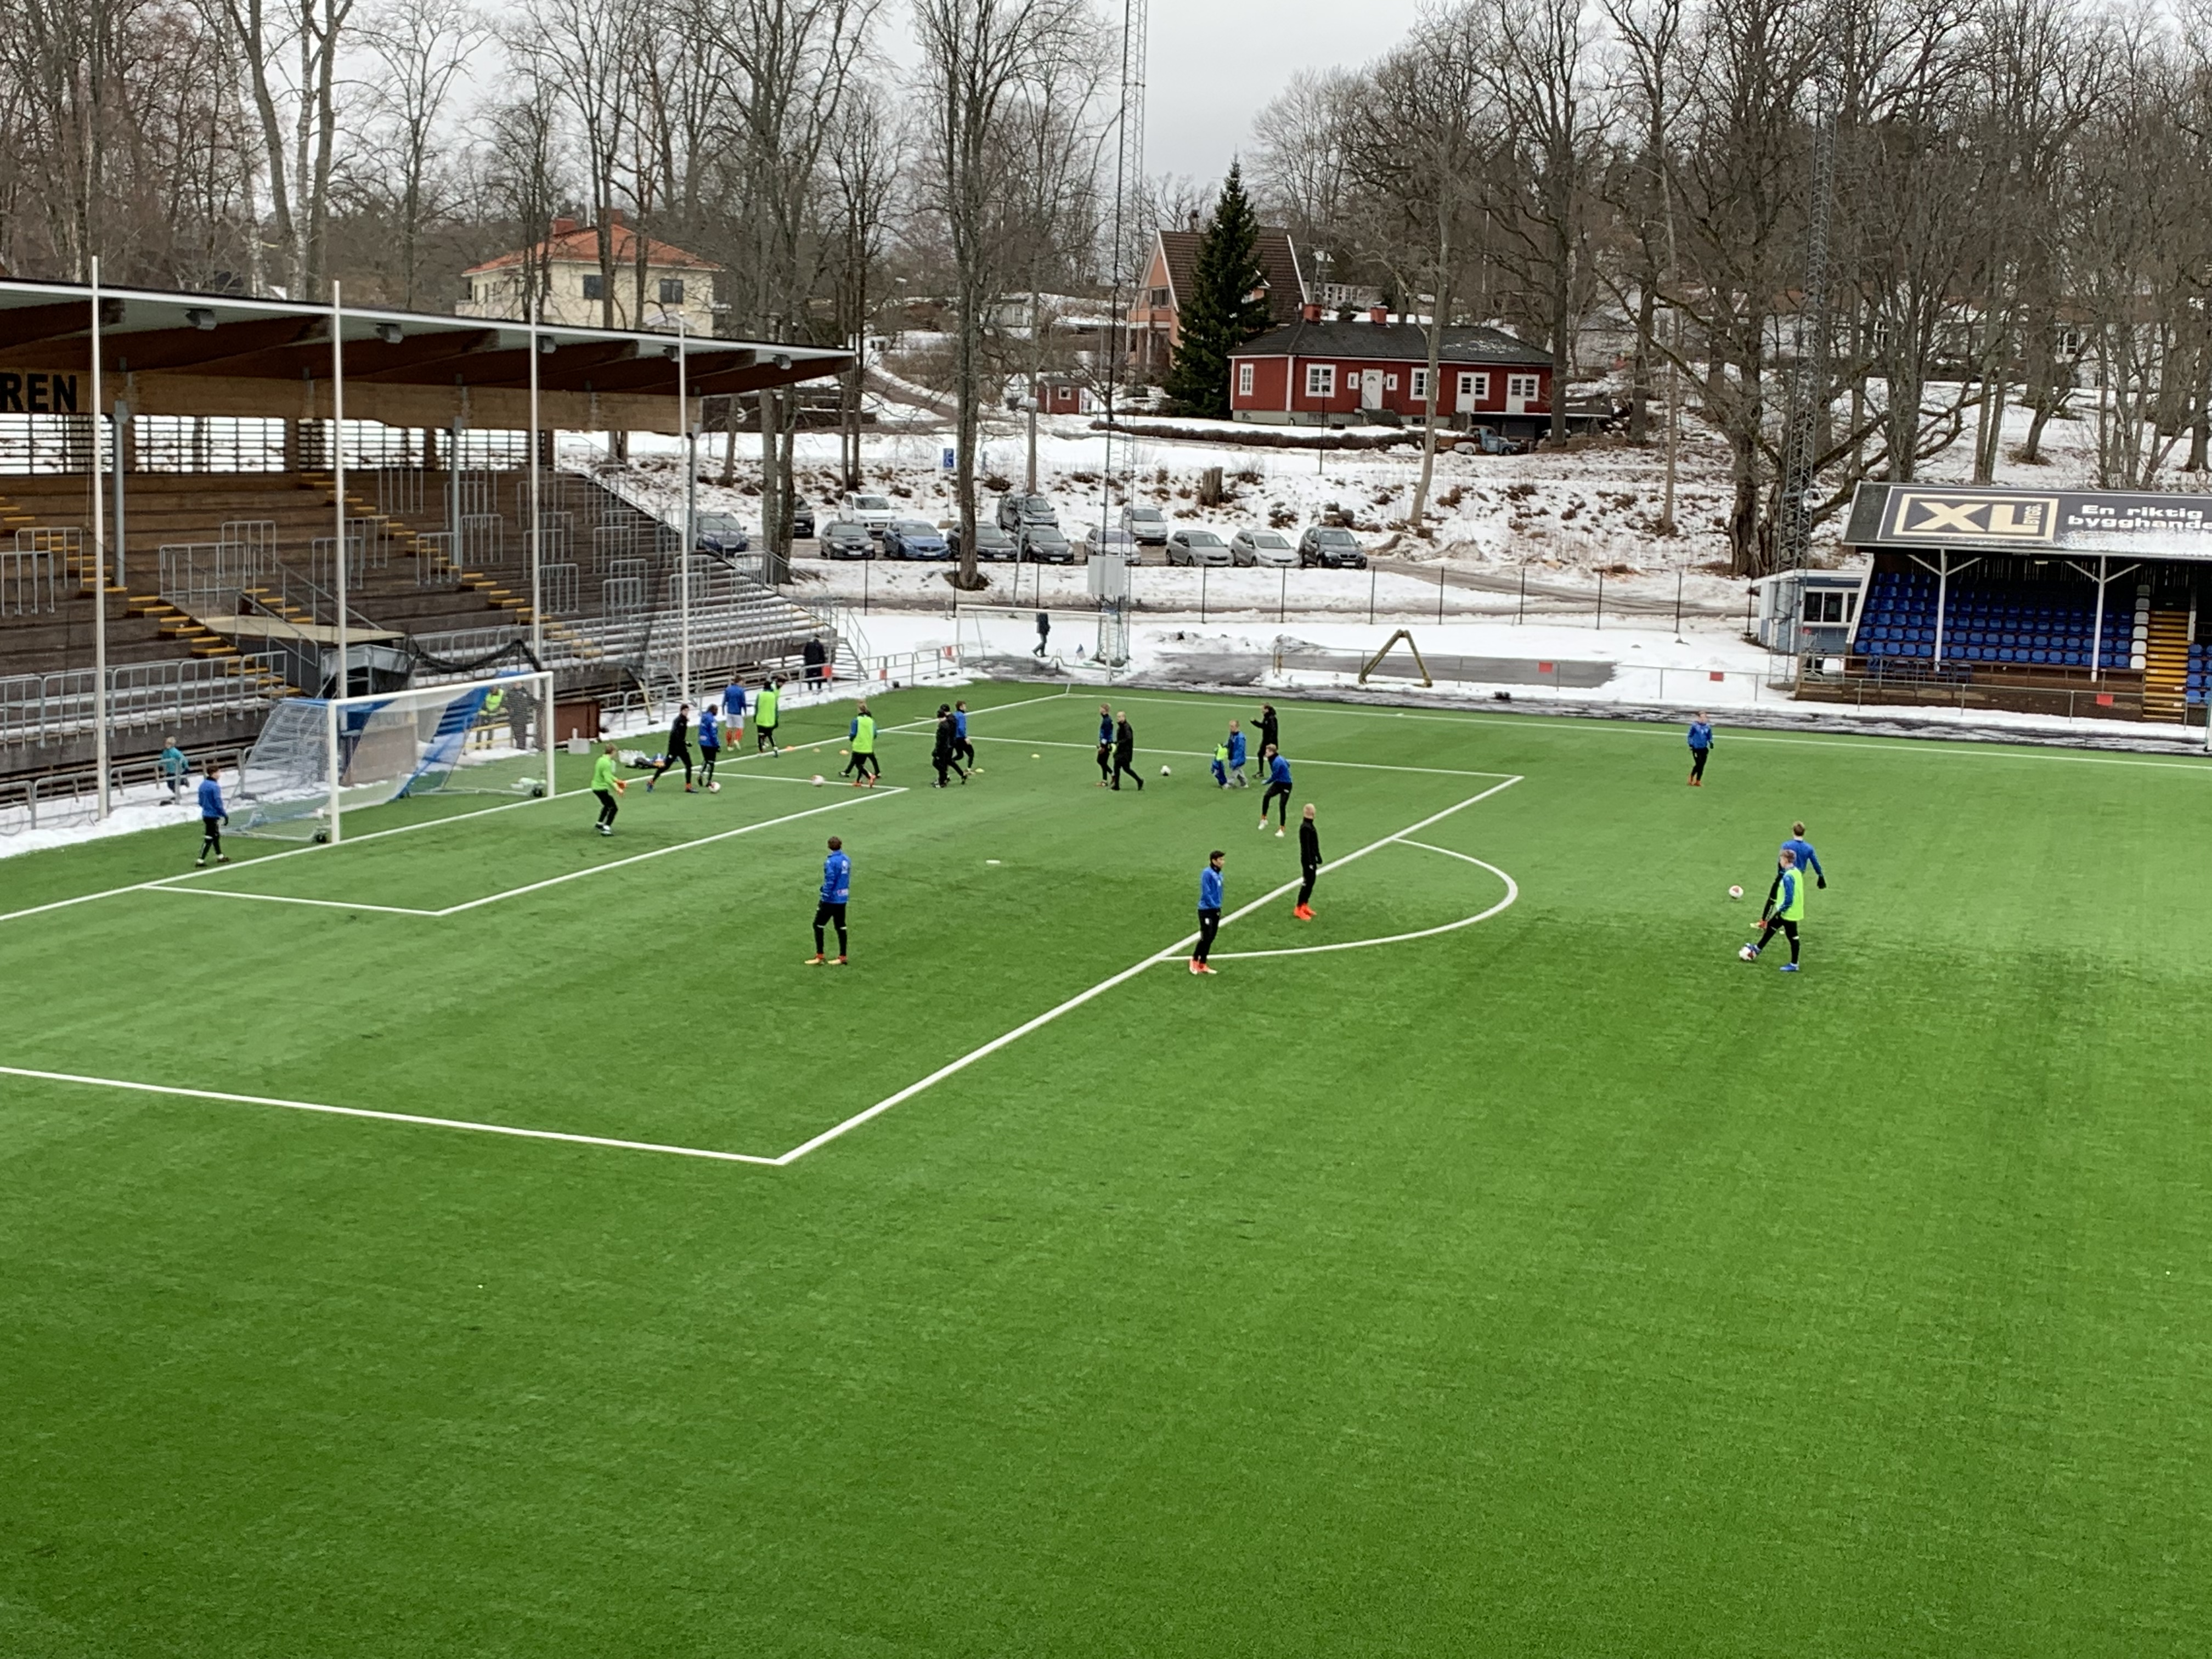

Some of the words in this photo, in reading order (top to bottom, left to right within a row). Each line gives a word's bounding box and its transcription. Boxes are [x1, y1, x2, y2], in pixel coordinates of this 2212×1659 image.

[0, 373, 77, 412] REN
[1910, 501, 2039, 533] XL
[2081, 505, 2115, 515] En
[2127, 506, 2203, 520] riktig
